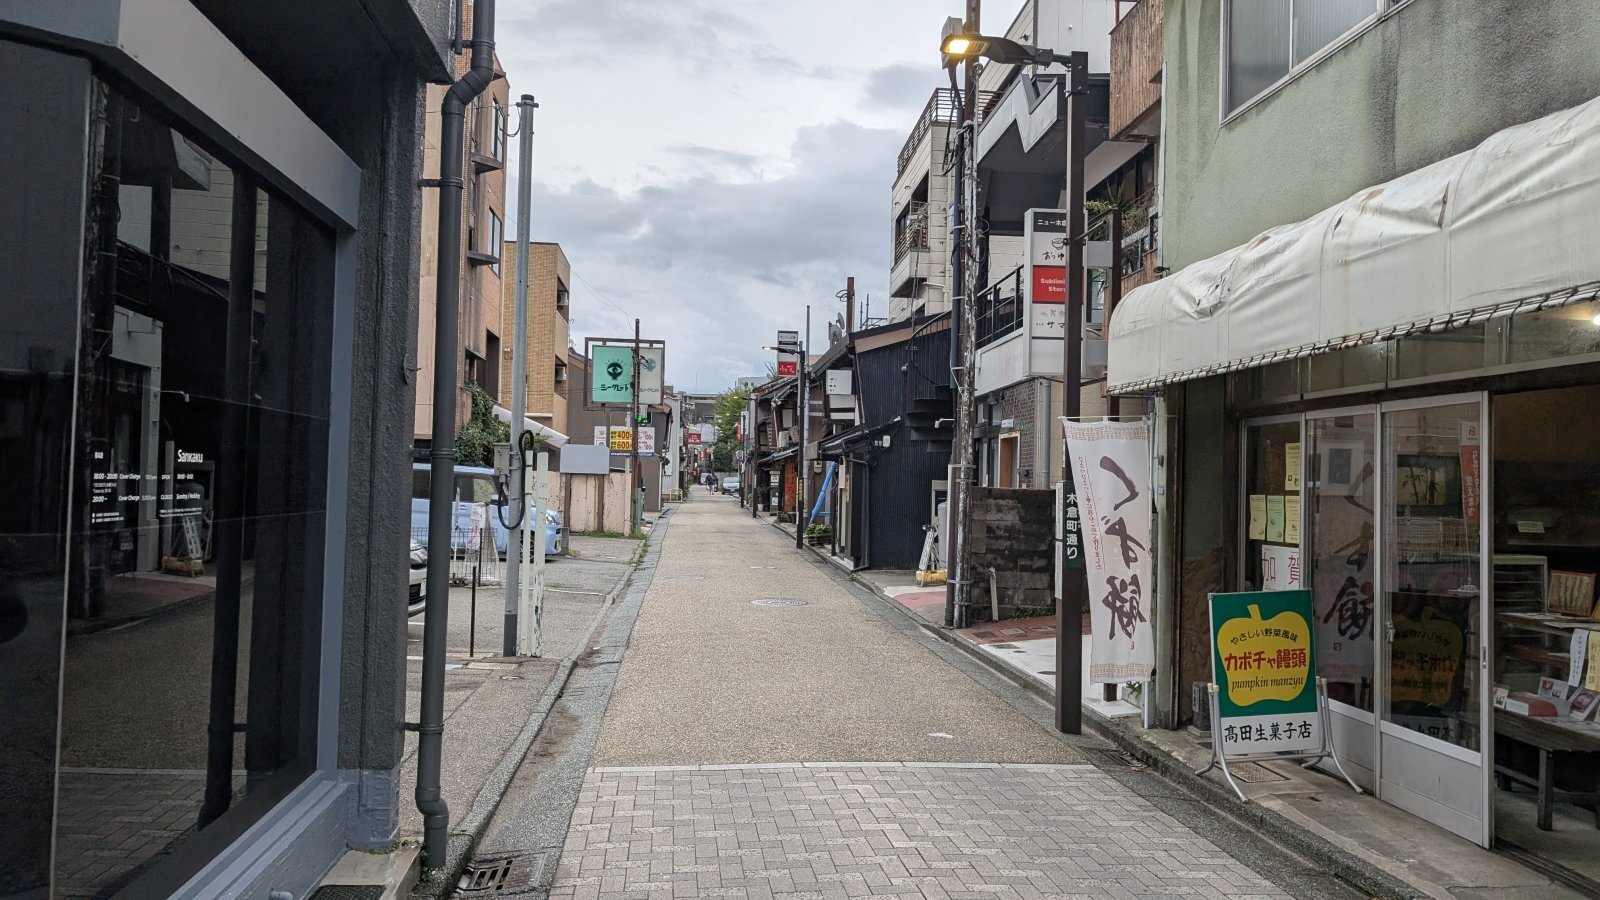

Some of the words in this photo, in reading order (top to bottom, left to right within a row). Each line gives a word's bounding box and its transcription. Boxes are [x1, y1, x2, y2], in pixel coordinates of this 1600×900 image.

[178, 449, 203, 462] Sankaku
[1066, 493, 1079, 560] 木倉町通り
[1230, 628, 1299, 645] やさしい野菜風味
[1224, 648, 1307, 672] カボチャ饅頭
[1231, 675, 1269, 693] pumpkin
[1270, 675, 1304, 690] manzyu
